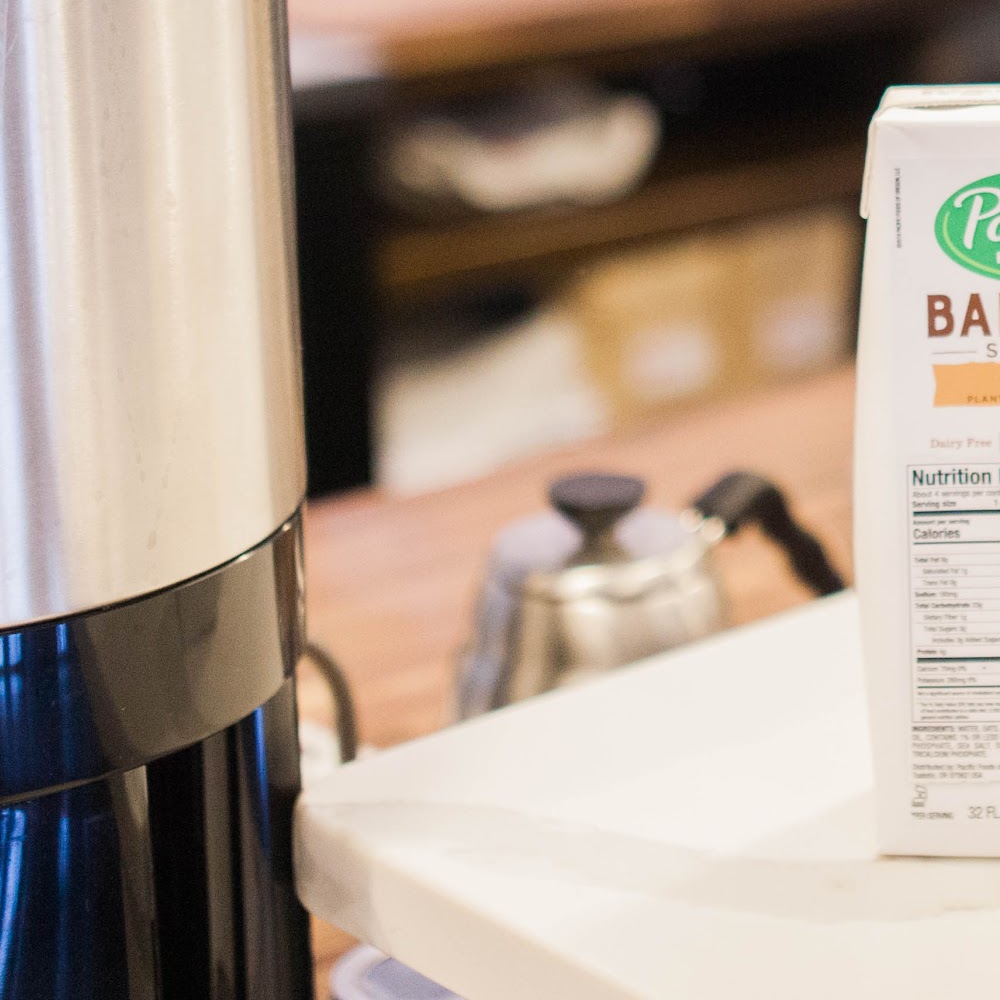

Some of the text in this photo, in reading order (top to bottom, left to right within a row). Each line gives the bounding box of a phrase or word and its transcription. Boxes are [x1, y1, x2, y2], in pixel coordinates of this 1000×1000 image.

[930, 437, 992, 450] Dairy Free
[912, 468, 992, 486] Nutrition
[912, 501, 940, 509] Serving
[913, 527, 961, 540] Calories
[968, 806, 983, 820] 32
